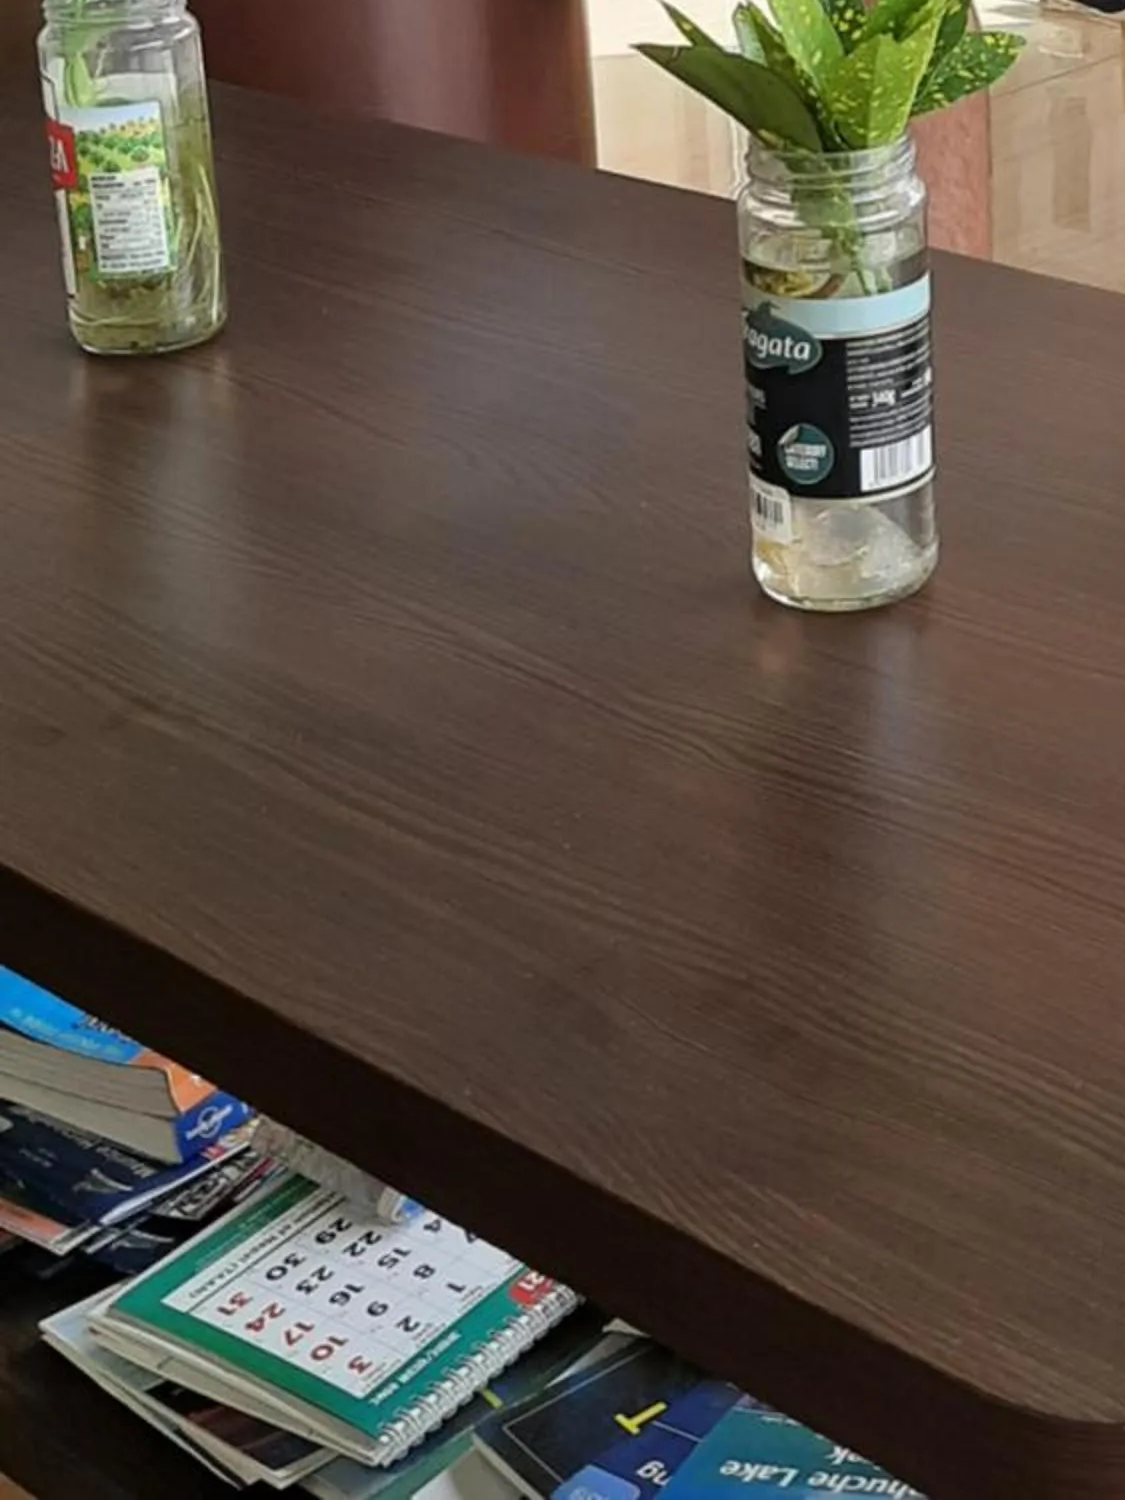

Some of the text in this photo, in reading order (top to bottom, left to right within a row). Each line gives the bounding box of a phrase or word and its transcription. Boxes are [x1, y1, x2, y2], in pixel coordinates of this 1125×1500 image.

[216, 1218, 353, 1317] 29 30 31
[245, 1230, 383, 1333] 22 23 24
[284, 1219, 443, 1347] 4 15 16 17
[413, 1264, 437, 1280] 8
[347, 1281, 467, 1375] 1 2 3
[366, 1300, 390, 1318] 9
[309, 1335, 350, 1362] 10
[719, 1459, 800, 1488] Lake
